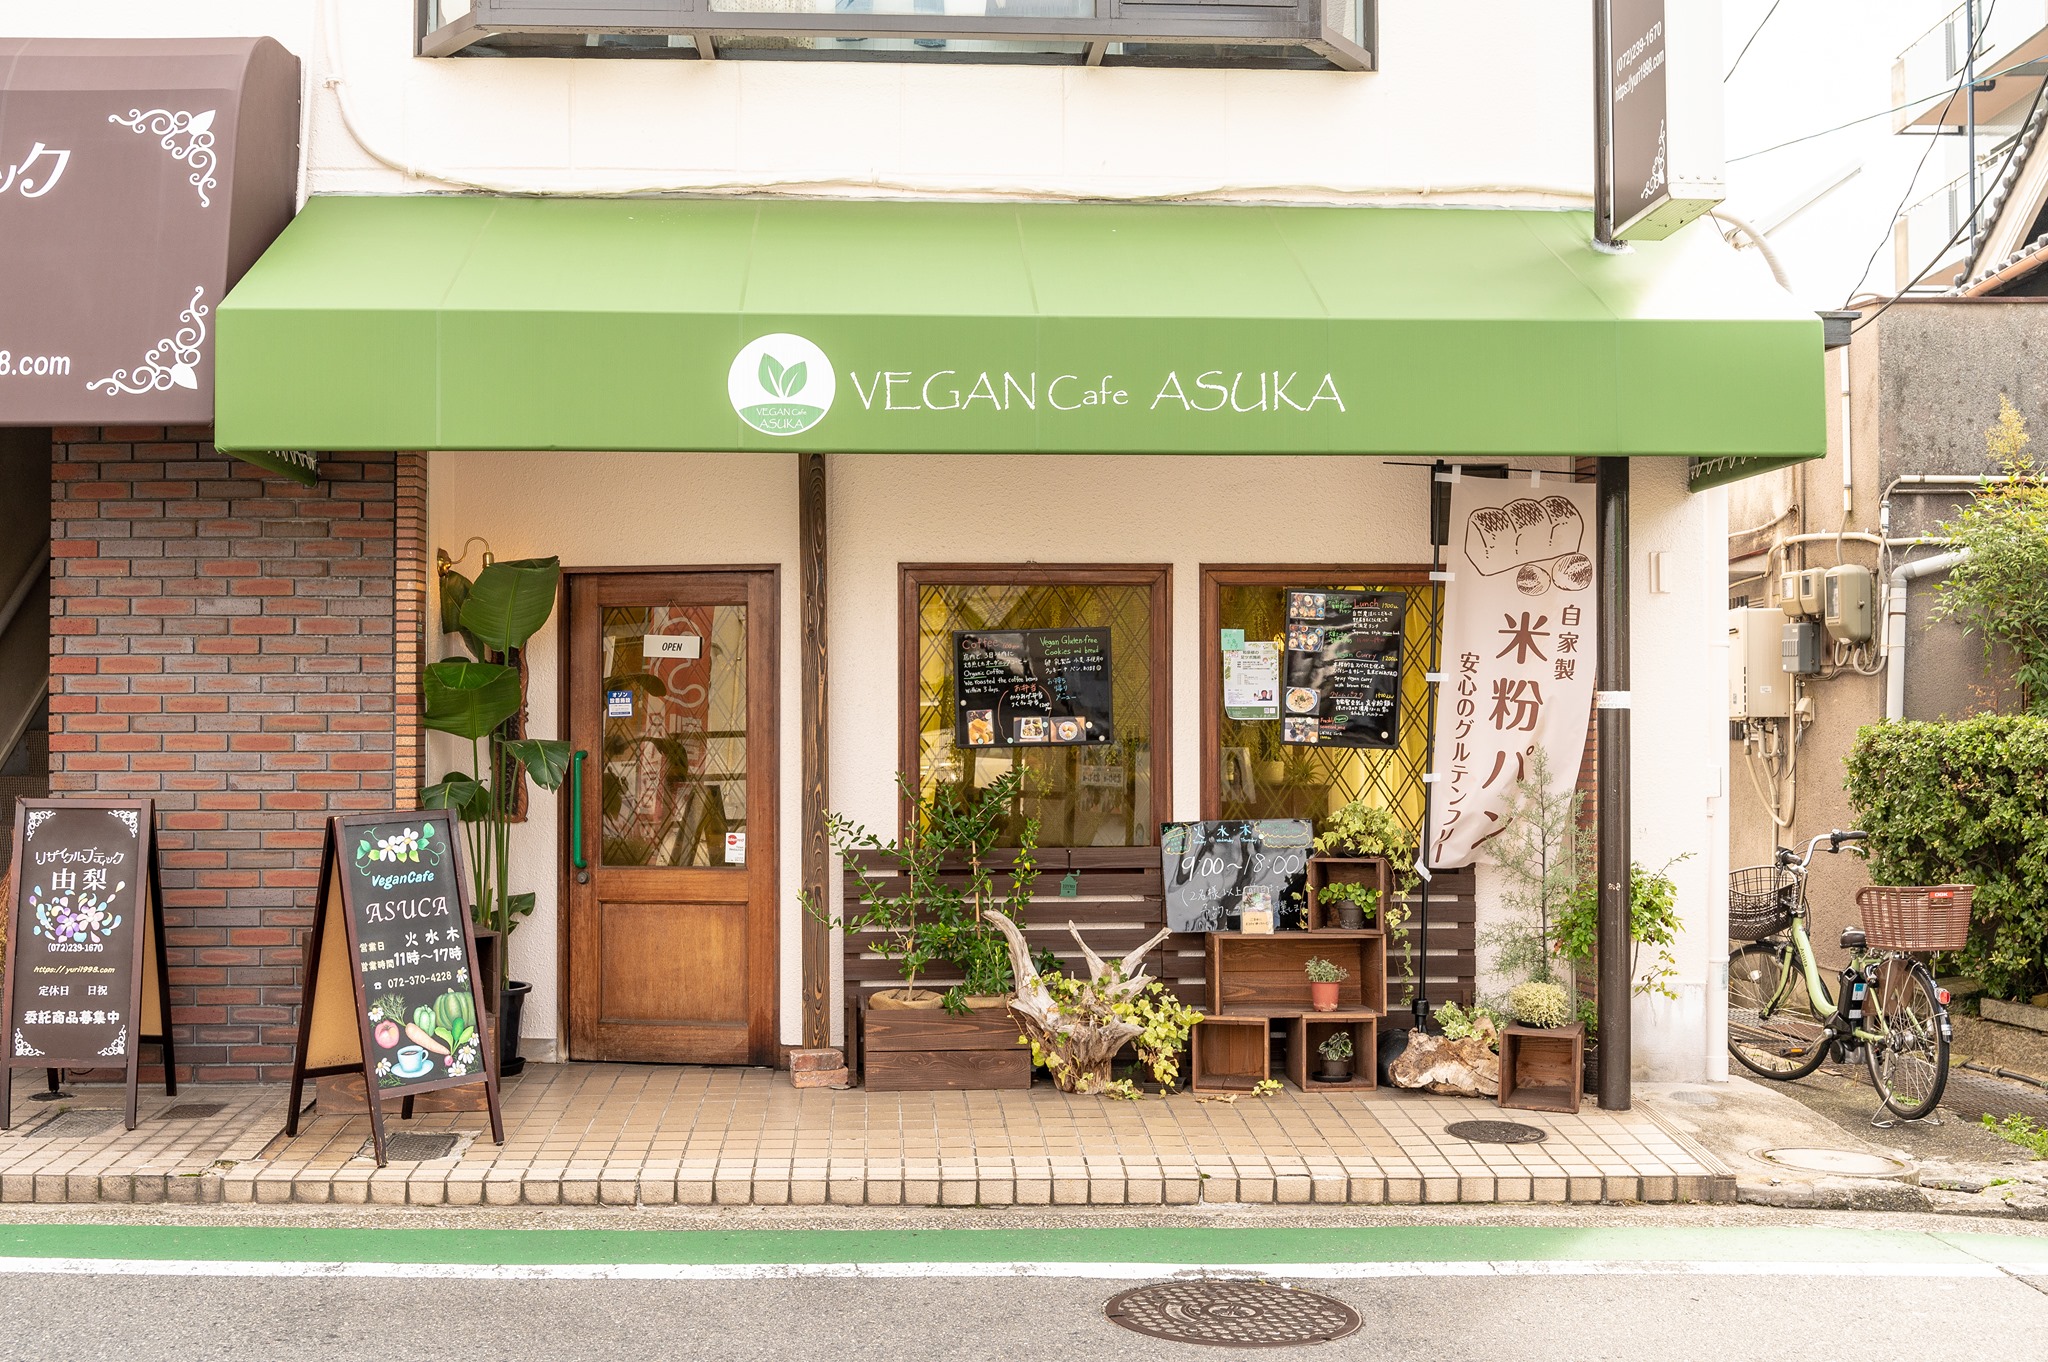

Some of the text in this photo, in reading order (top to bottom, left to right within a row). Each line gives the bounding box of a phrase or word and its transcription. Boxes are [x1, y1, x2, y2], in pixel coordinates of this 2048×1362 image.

[1616, 20, 1662, 77] (072)239-1670
[850, 370, 1346, 412] VEGAN Cafe ASUKA
[756, 407, 807, 416] VEGAN Cafe
[759, 418, 804, 429] ASUKA
[1353, 598, 1379, 609] Lunch
[661, 641, 683, 652] OPEN
[962, 638, 1000, 650] Coffee
[1039, 636, 1060, 648] Vegan
[1553, 603, 1582, 682] 自家製
[1044, 647, 1071, 656] Cookies
[1084, 645, 1099, 654] bread
[1355, 650, 1377, 660] Curry
[963, 670, 985, 678] Organic
[974, 676, 995, 685] roasted
[1008, 675, 1024, 683] coffee
[1014, 683, 1037, 693] お弁当
[1055, 693, 1076, 701] メニュー
[1470, 610, 1550, 850] 米粉パン
[1434, 651, 1481, 864] 安心のグルテンフリー
[35, 846, 125, 866] リサイクルブティック
[51, 867, 108, 891] 由梨
[365, 896, 449, 924] ASUCA
[359, 926, 460, 953] 営業日 火 水 木
[47, 942, 104, 953] (072)239-1670
[361, 958, 395, 972] 営業時間
[387, 971, 452, 989] 072-370-4228
[38, 985, 108, 996] 定休日 日祝
[24, 1010, 120, 1025] 委託商品募集中
